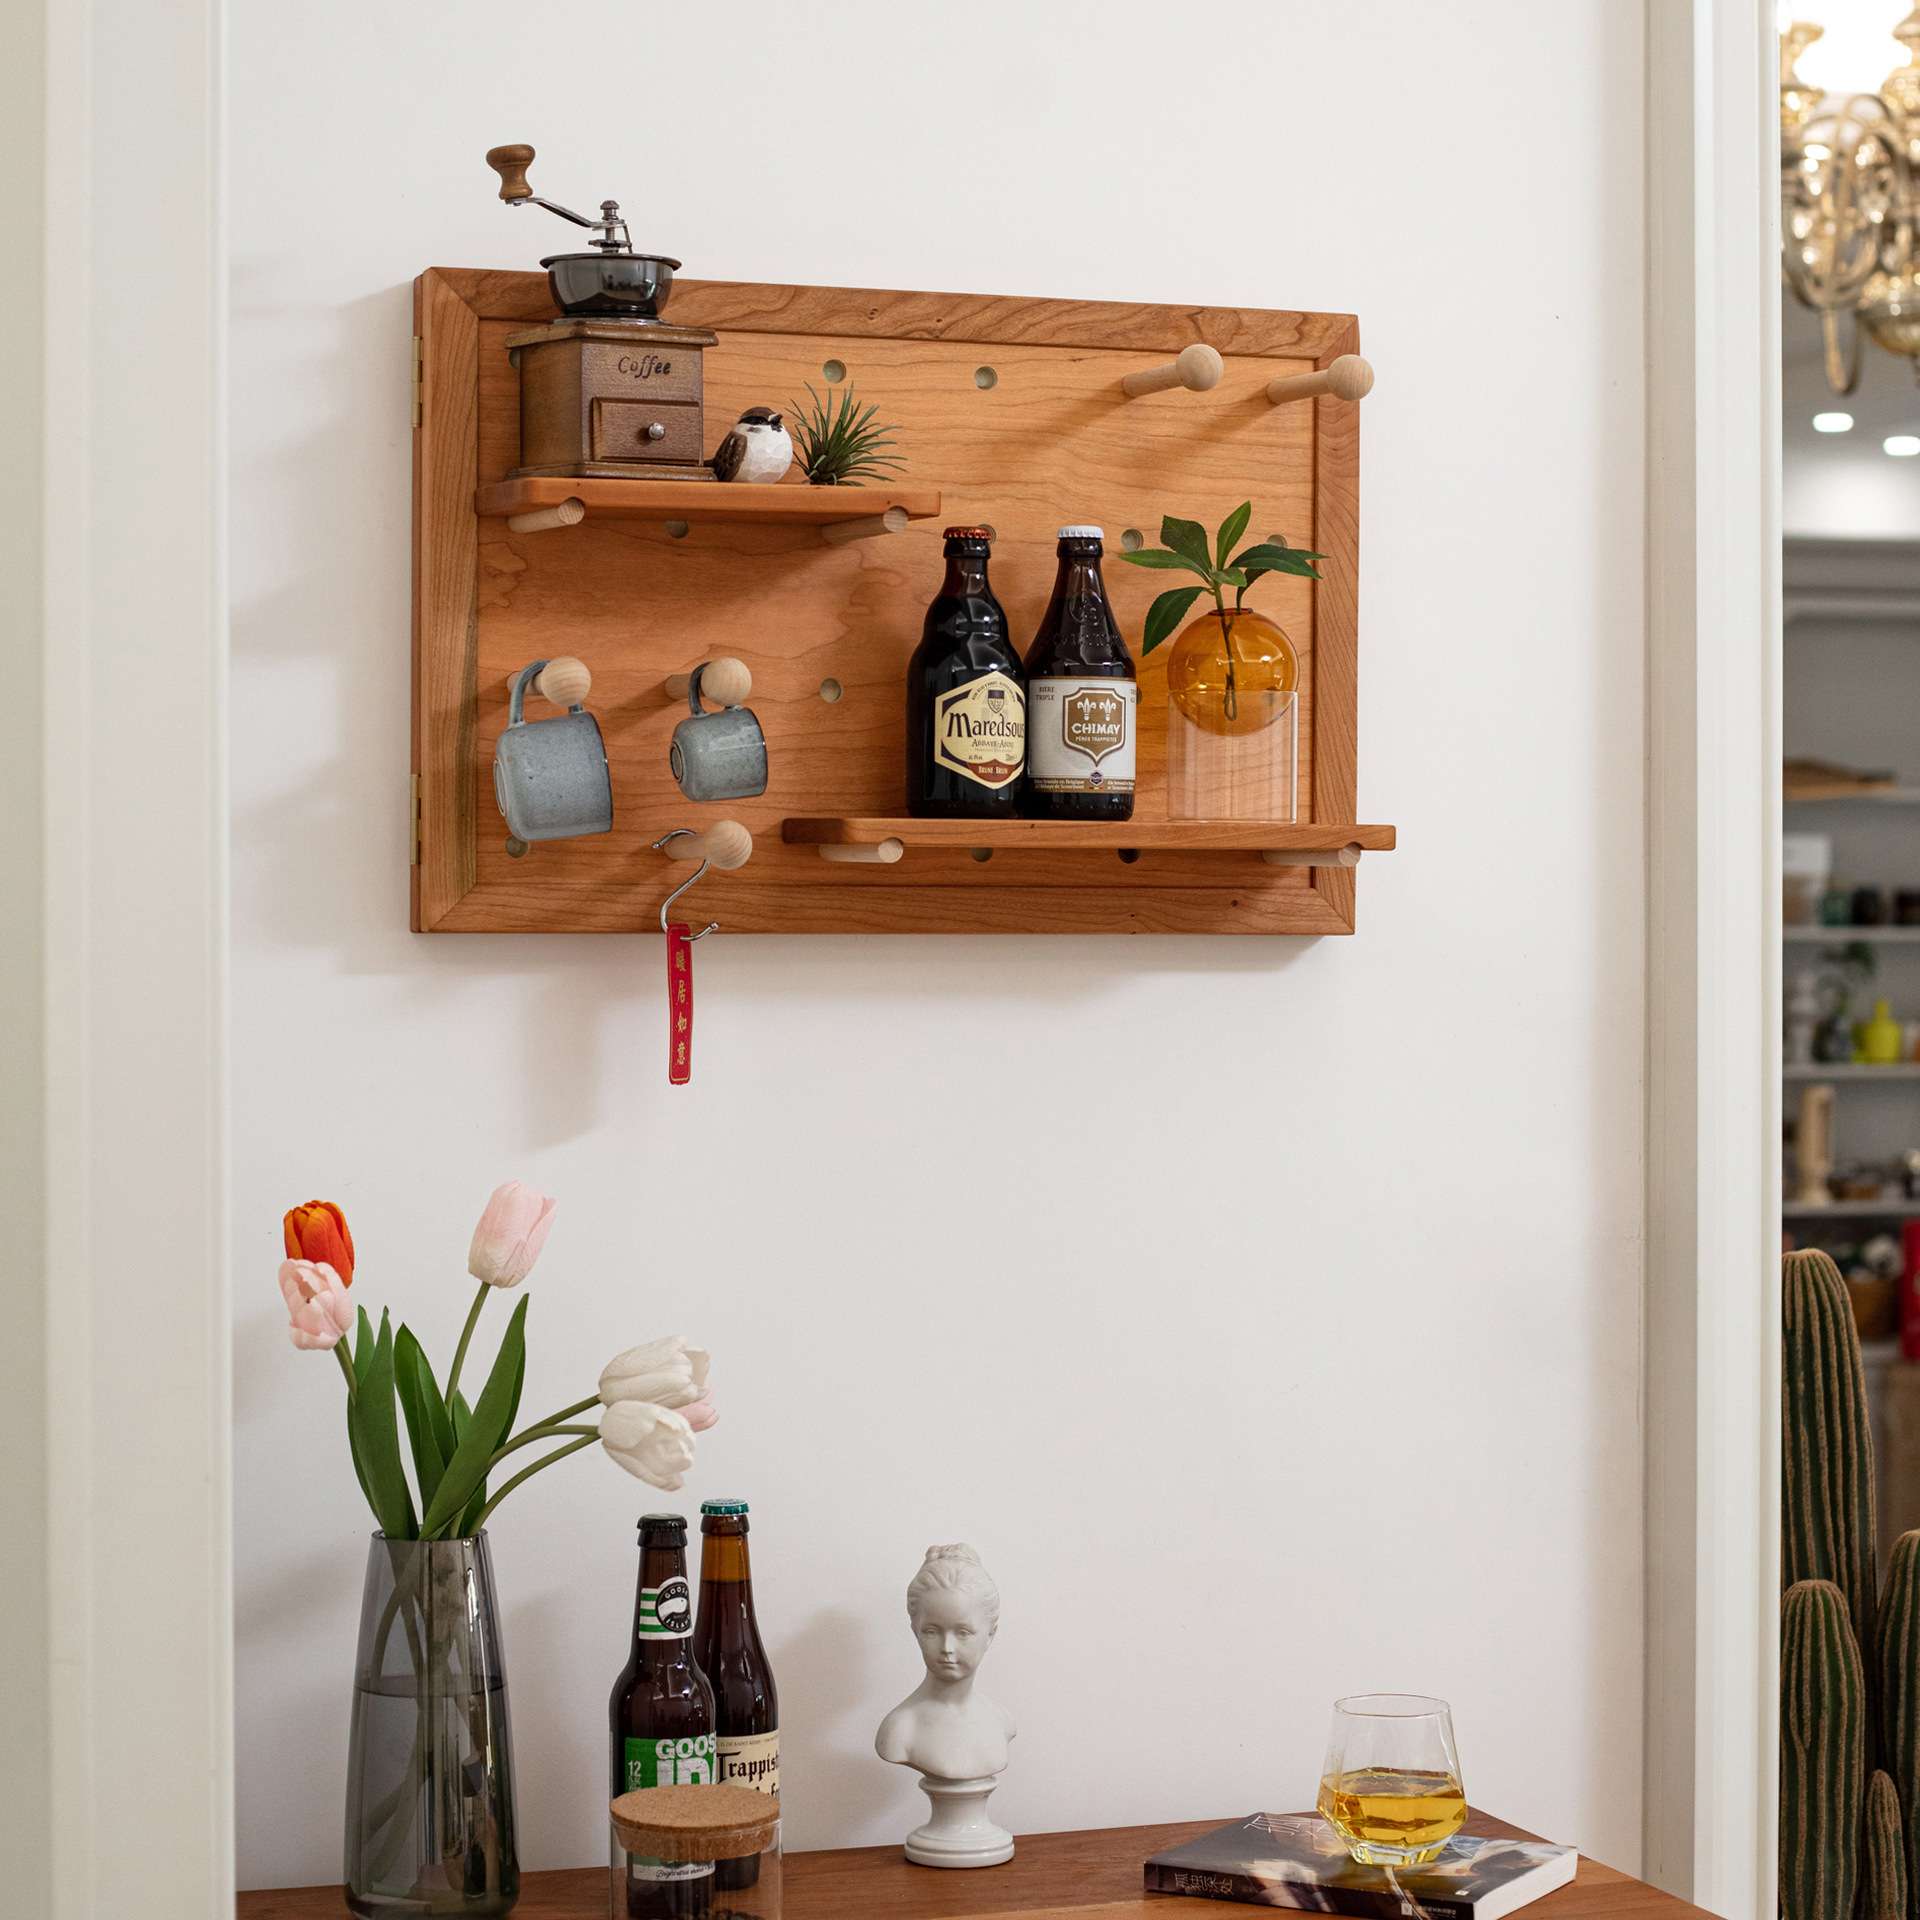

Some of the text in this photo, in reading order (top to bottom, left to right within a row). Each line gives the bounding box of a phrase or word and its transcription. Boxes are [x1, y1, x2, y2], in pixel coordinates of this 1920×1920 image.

[618, 355, 671, 379] Coffee
[1071, 723, 1120, 735] CHIMAY
[628, 1760, 641, 1777] 12
